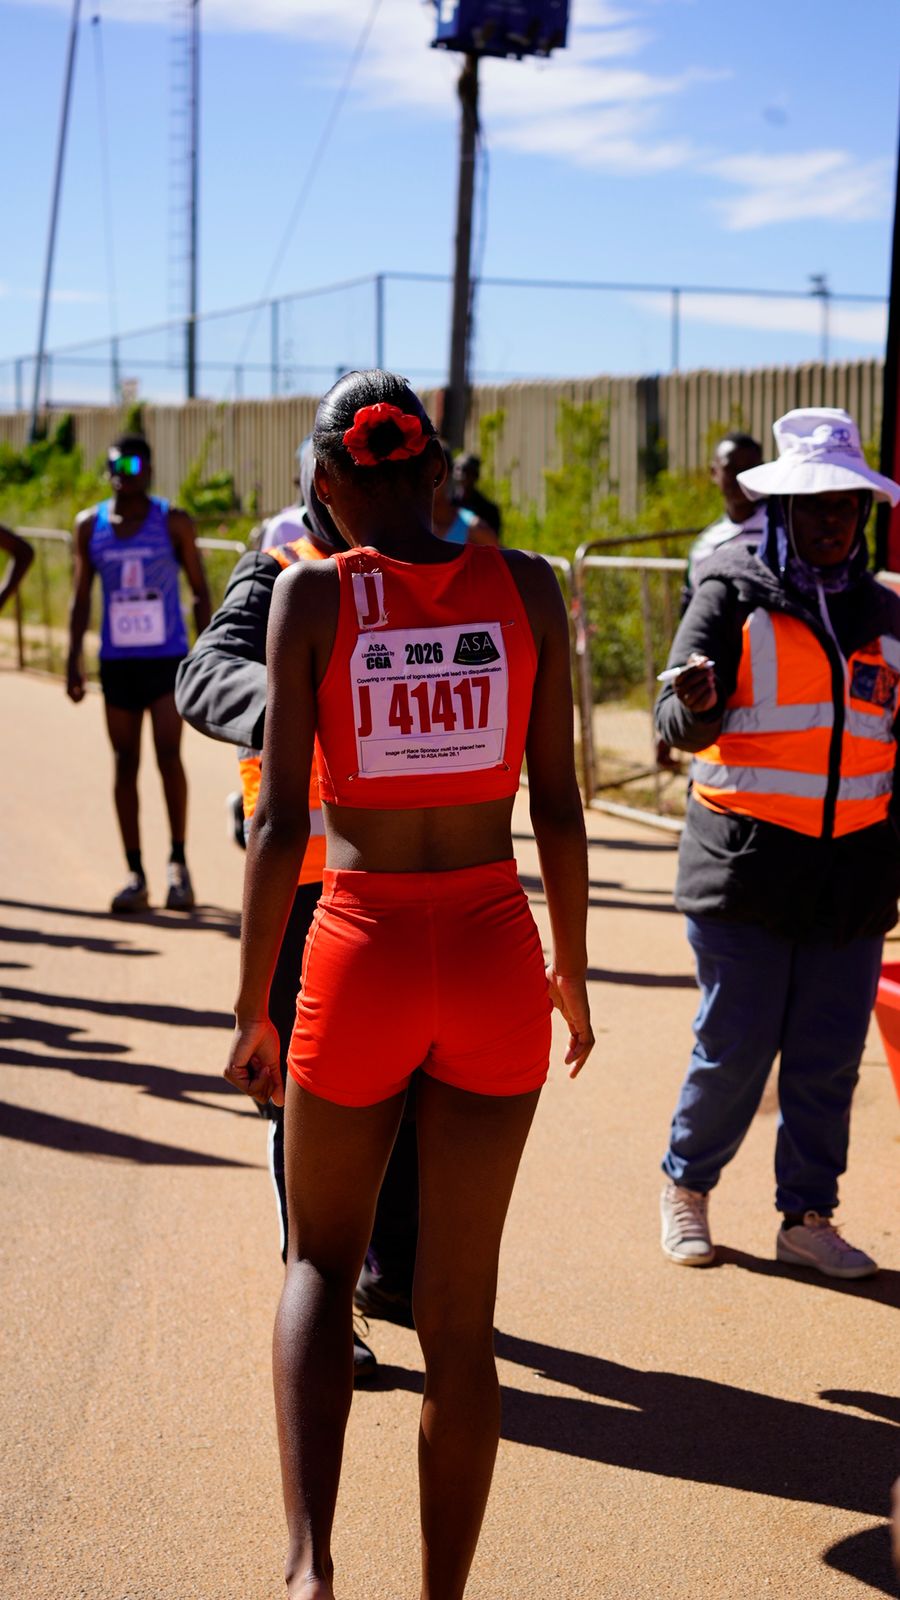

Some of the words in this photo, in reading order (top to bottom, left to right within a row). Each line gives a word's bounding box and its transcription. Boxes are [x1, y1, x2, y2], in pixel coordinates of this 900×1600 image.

[362, 576, 379, 626] J
[368, 643, 388, 652] ASA
[459, 635, 493, 652] ASA
[405, 642, 443, 665] 2026
[366, 656, 392, 670] CGA
[468, 666, 502, 675] disqualification
[358, 685, 373, 737] J
[388, 676, 490, 734] 41417
